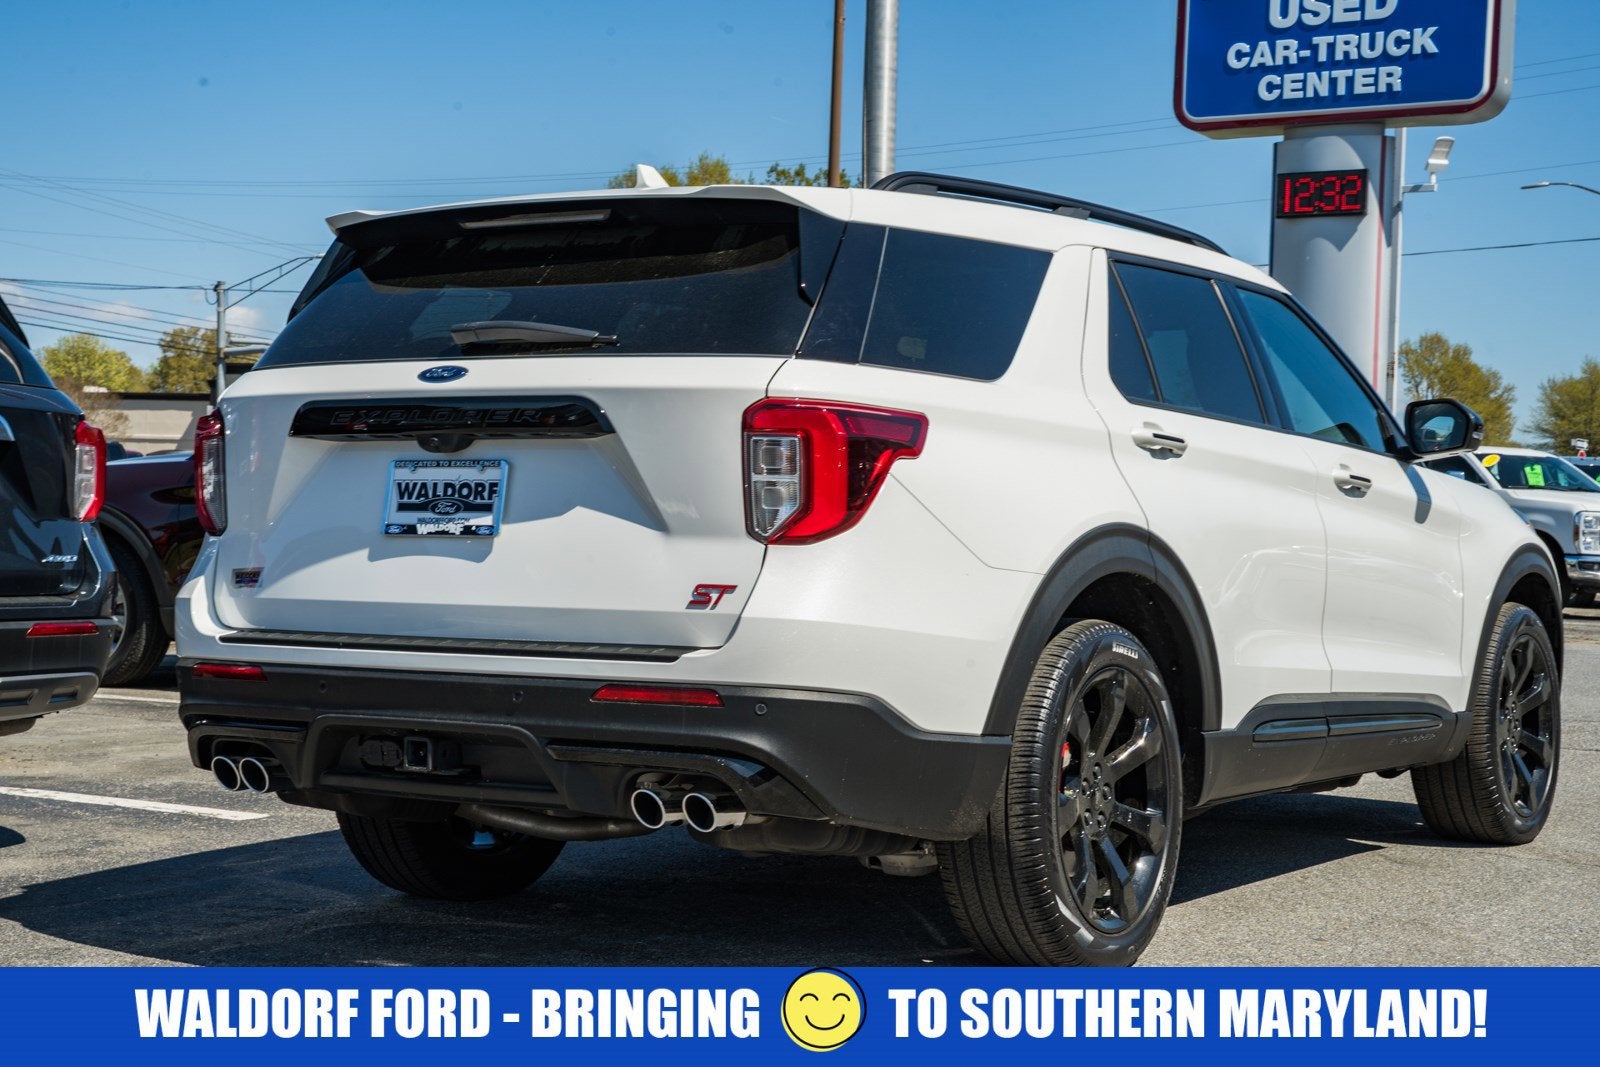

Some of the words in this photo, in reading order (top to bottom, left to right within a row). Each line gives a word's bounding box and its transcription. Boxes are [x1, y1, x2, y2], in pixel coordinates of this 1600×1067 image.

[1268, 0, 1400, 29] USED
[1226, 26, 1440, 70] CAR-TRUCK
[1257, 65, 1403, 102] CENTER
[330, 407, 543, 426] EXPLORER
[397, 482, 499, 500] WALDORF
[435, 502, 457, 513] Ford
[685, 584, 738, 610] ST
